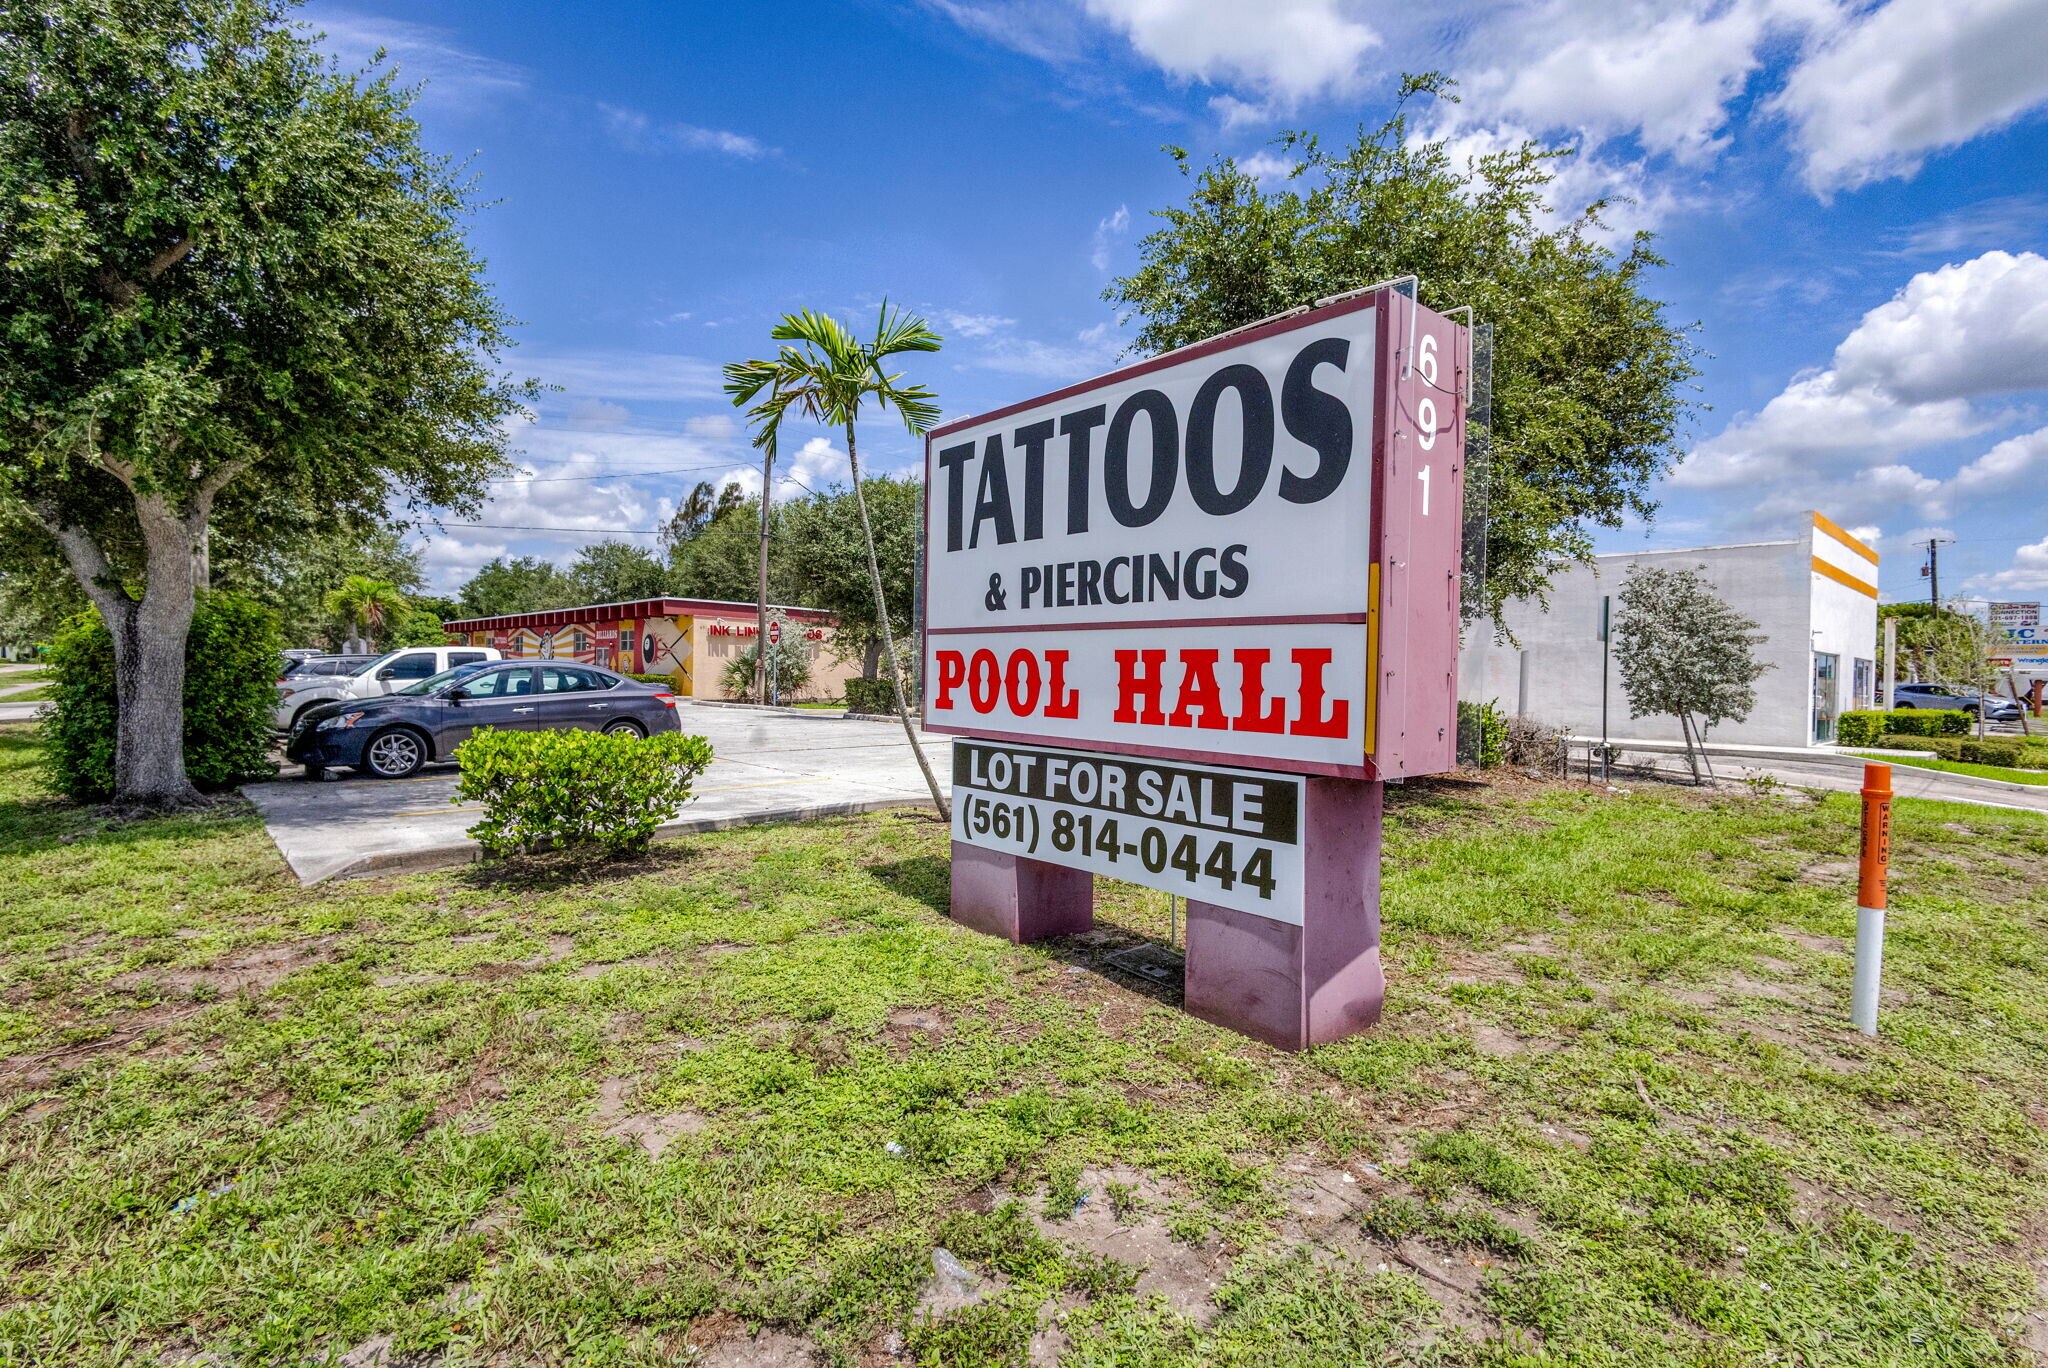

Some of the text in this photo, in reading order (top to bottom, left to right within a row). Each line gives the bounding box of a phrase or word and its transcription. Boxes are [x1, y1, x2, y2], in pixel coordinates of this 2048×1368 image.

[939, 337, 1353, 552] TATTOOS
[985, 544, 1249, 611] & PIERCINGS
[596, 630, 618, 639] BILLIARDS
[709, 624, 730, 636] INK
[935, 648, 1349, 739] POOL HALL
[970, 749, 1264, 833] LOT FOR SALE
[963, 793, 1277, 900] (561) 814-0444
[1880, 805, 1890, 862] WARNING
